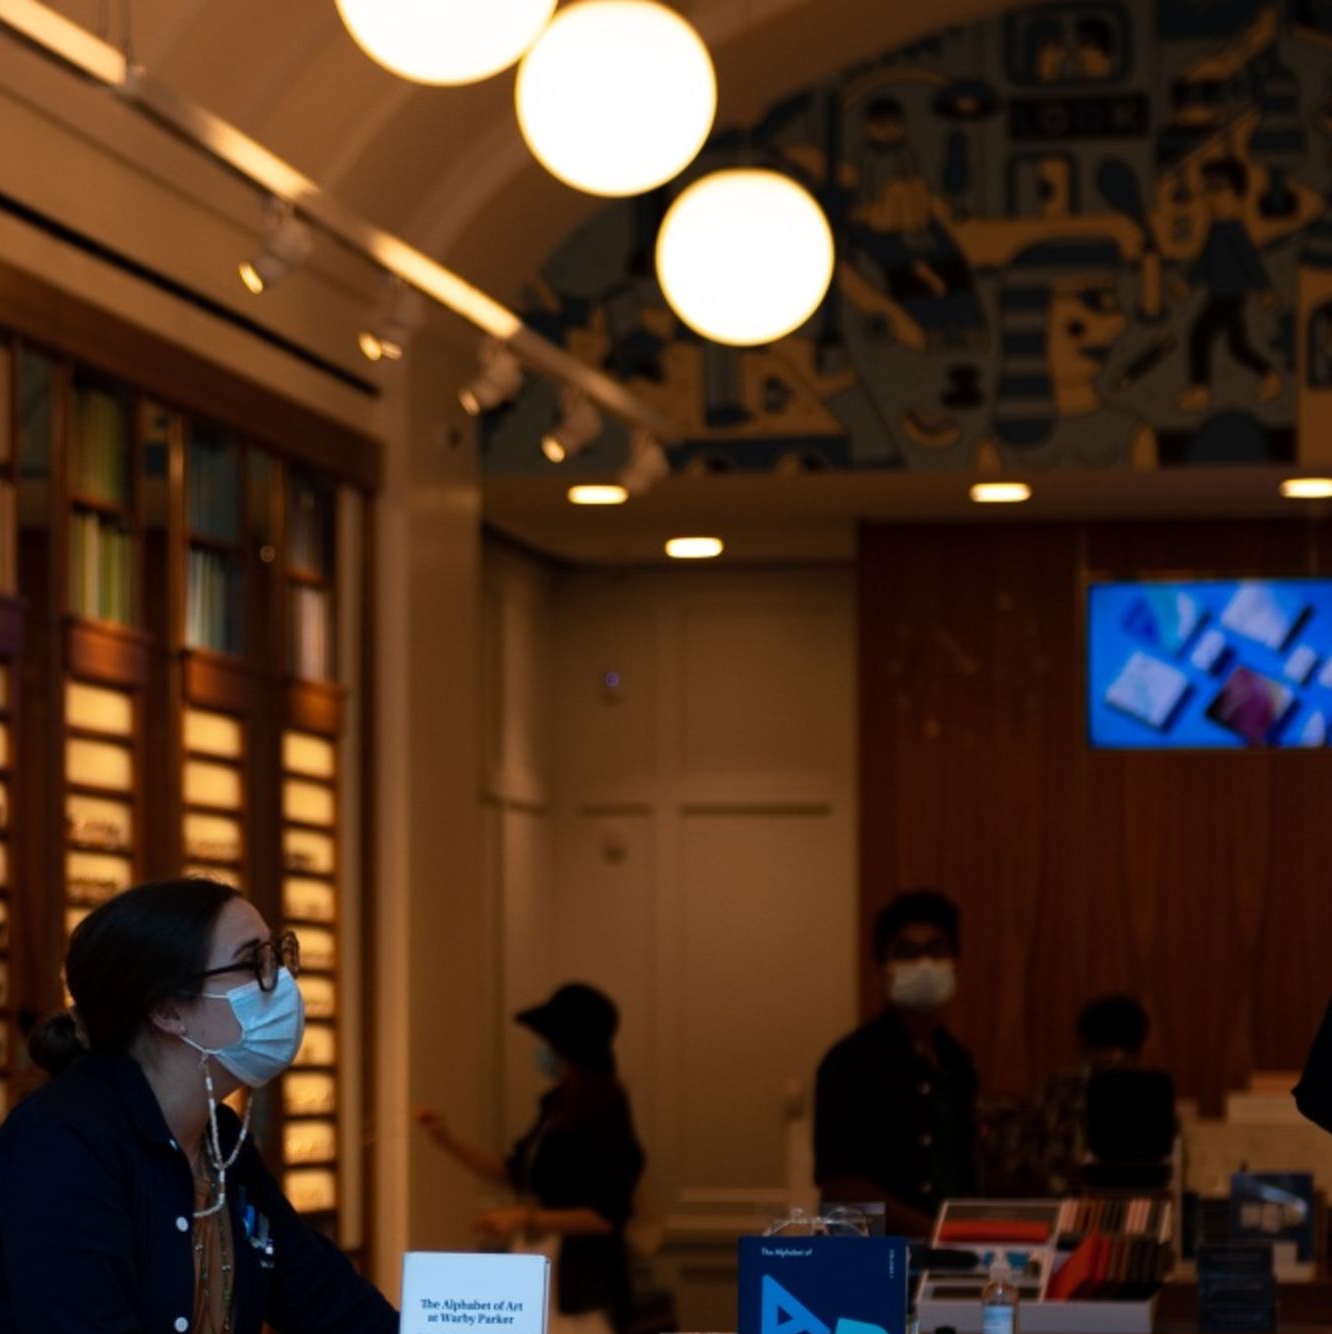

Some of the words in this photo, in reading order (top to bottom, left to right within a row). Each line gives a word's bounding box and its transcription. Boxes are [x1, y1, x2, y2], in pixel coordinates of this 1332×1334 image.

[420, 1298, 440, 1309] The
[442, 1299, 491, 1312] Alphabet
[493, 1300, 505, 1311] of
[506, 1301, 523, 1312] Art
[427, 1313, 438, 1322] at
[440, 1313, 475, 1326] Warby
[477, 1313, 515, 1325] Parker
